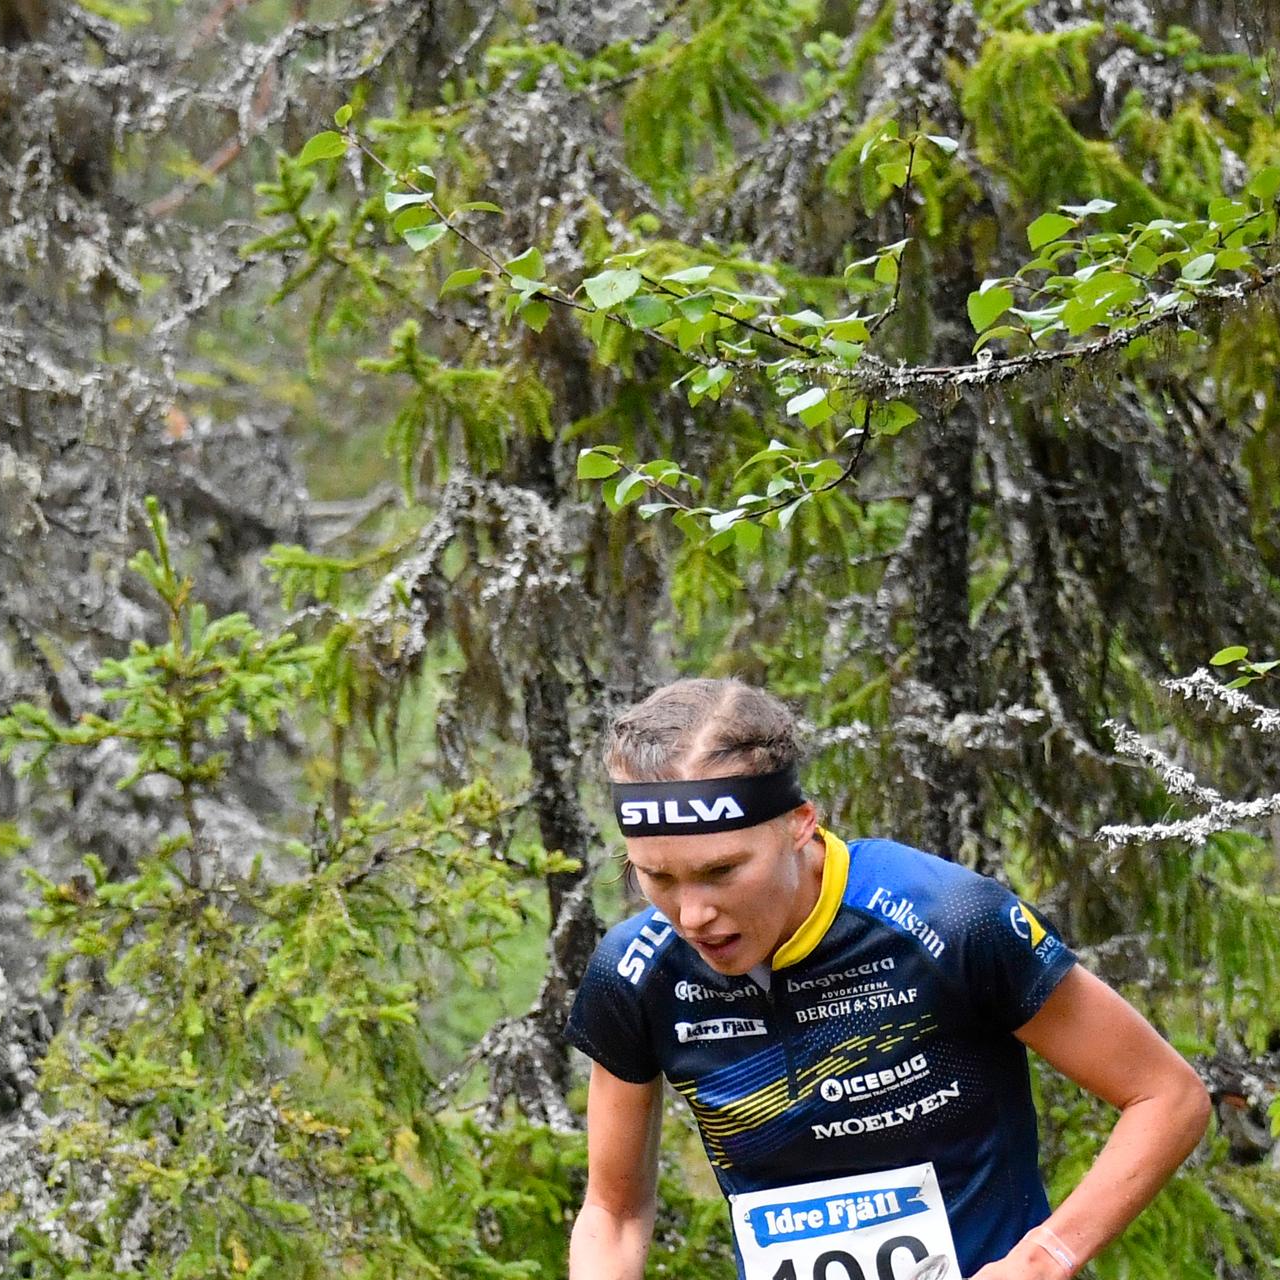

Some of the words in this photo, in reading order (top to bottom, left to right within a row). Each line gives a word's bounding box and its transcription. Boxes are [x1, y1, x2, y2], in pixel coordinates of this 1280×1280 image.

[621, 796, 745, 825] SILVA
[866, 887, 945, 959] Folksam
[786, 957, 896, 993] bagheera
[821, 981, 889, 1000] ADVOKATERNA
[795, 1000, 852, 1024] BERGH
[853, 999, 868, 1013] &
[869, 988, 918, 1010] STAAF
[686, 1023, 720, 1038] Idre
[722, 1021, 757, 1036] Fjäll
[843, 1053, 928, 1095] ICEBUG
[811, 1081, 961, 1140] MOELVEN
[764, 1207, 824, 1235] Idre
[825, 1190, 902, 1229] Fjäll
